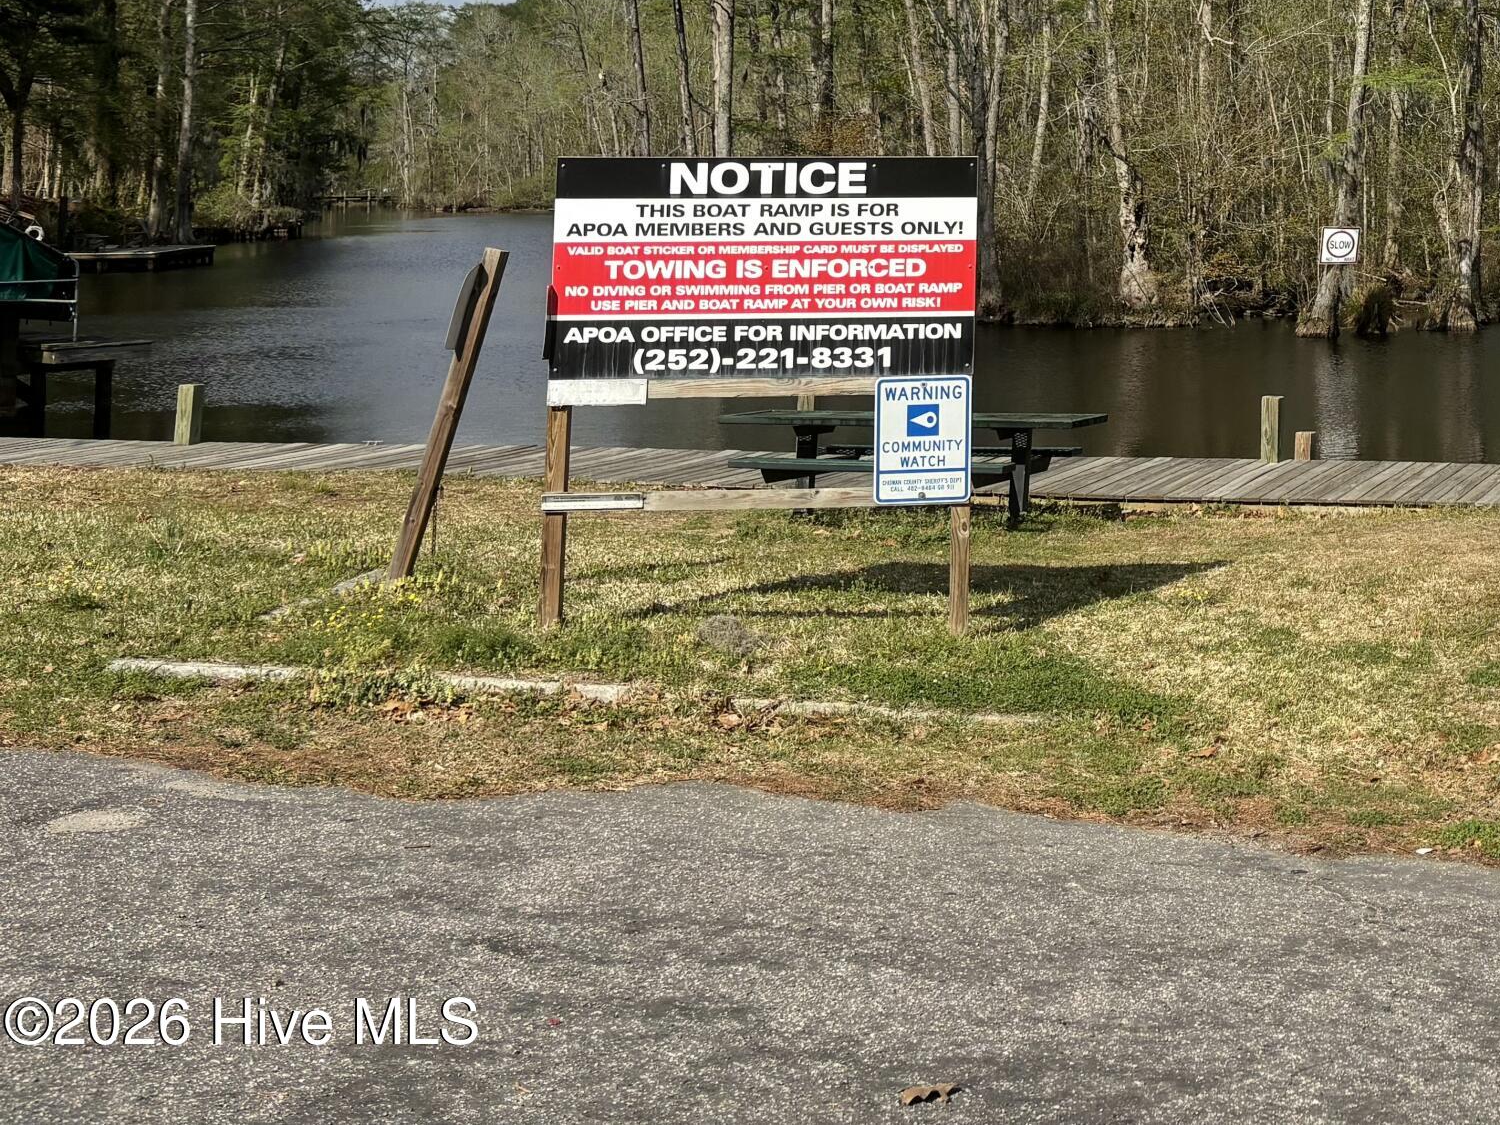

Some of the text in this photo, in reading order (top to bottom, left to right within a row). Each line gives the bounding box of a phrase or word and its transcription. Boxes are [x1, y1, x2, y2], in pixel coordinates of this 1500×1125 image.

[669, 161, 868, 195] NOTICE
[636, 203, 899, 218] THIS BOAT RAMP IS FOR
[566, 221, 964, 237] APOA MEMBERS AND GUESTS ONLY!
[567, 244, 964, 255] VALID BOAT STICKER OR MEMBERSHIP CARD MUST BE DISPLAYED
[1330, 240, 1351, 249] SLOW
[604, 258, 927, 280] TOWING IS ENFORCED
[565, 283, 963, 297] NO DIVING OR SWIMMING FROM PIER OR BOAT RAMP
[590, 297, 941, 311] USE PIER AND BOAT RAMP AT YOUR OWN RISK!
[563, 323, 962, 344] APOA OFFICE FOR INFORMATION
[633, 346, 892, 374] (252)-221-8331
[885, 385, 963, 401] WARNING
[882, 439, 963, 454] COMMUNITY
[900, 455, 946, 468] WATCH
